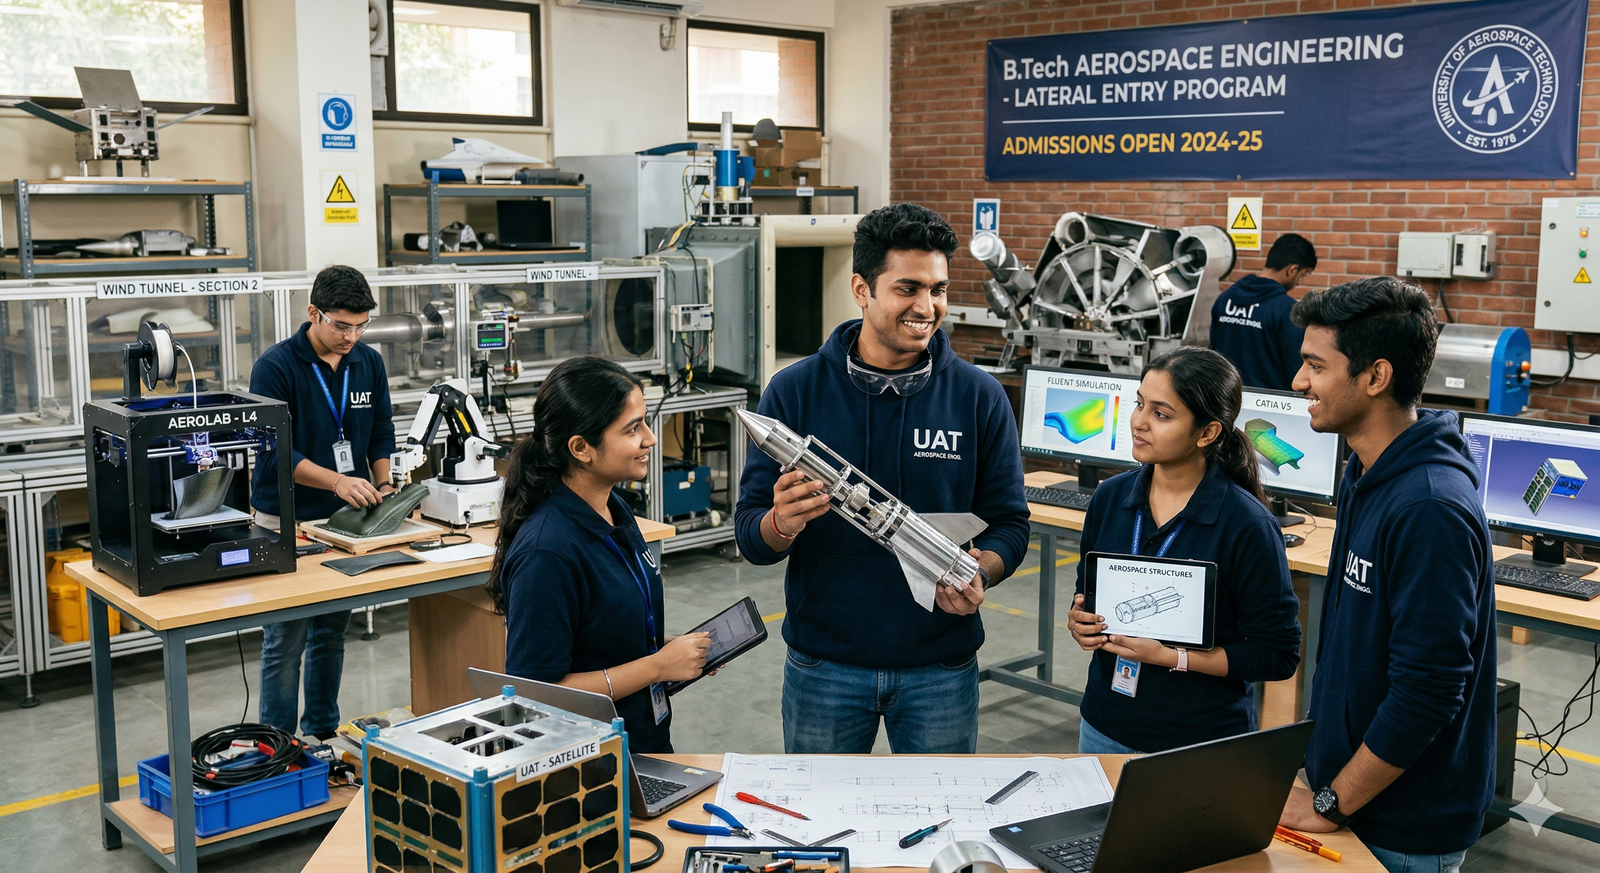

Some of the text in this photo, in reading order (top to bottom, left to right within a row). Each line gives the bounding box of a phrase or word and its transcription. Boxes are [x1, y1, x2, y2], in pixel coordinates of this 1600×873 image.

[1003, 32, 1404, 81] B.Tech AEROSPACE ENGINEERING
[1437, 30, 1553, 128] UNIVERSITY OF AEROSPACE TECHNOLOGY
[1015, 84, 1097, 107] LATERAL
[1102, 80, 1168, 104] ENTRY
[1173, 74, 1286, 101] PROGRAM
[1002, 130, 1263, 155] ADMISSIONS OPEN 2024-25
[1465, 133, 1517, 148] EST. 1978
[530, 270, 553, 280] WIND
[555, 269, 587, 279] TUNNEL
[103, 284, 136, 296] WIND
[139, 282, 188, 294] TUNNEL
[198, 280, 249, 292] SECTION
[252, 280, 258, 290] 2
[1047, 376, 1122, 391] FLUENT SIMULATION
[350, 391, 372, 404] UAT
[1255, 399, 1279, 409] CATIA
[168, 412, 231, 430] AEROLAB
[242, 410, 258, 423] L4
[913, 428, 963, 452] UAT
[913, 451, 947, 459] AEROSPACE
[1109, 564, 1193, 579] AEROSPACE STRUCTURES
[1345, 549, 1373, 583] UAT
[521, 761, 540, 777] UAT
[548, 742, 596, 768] SATELLITE
